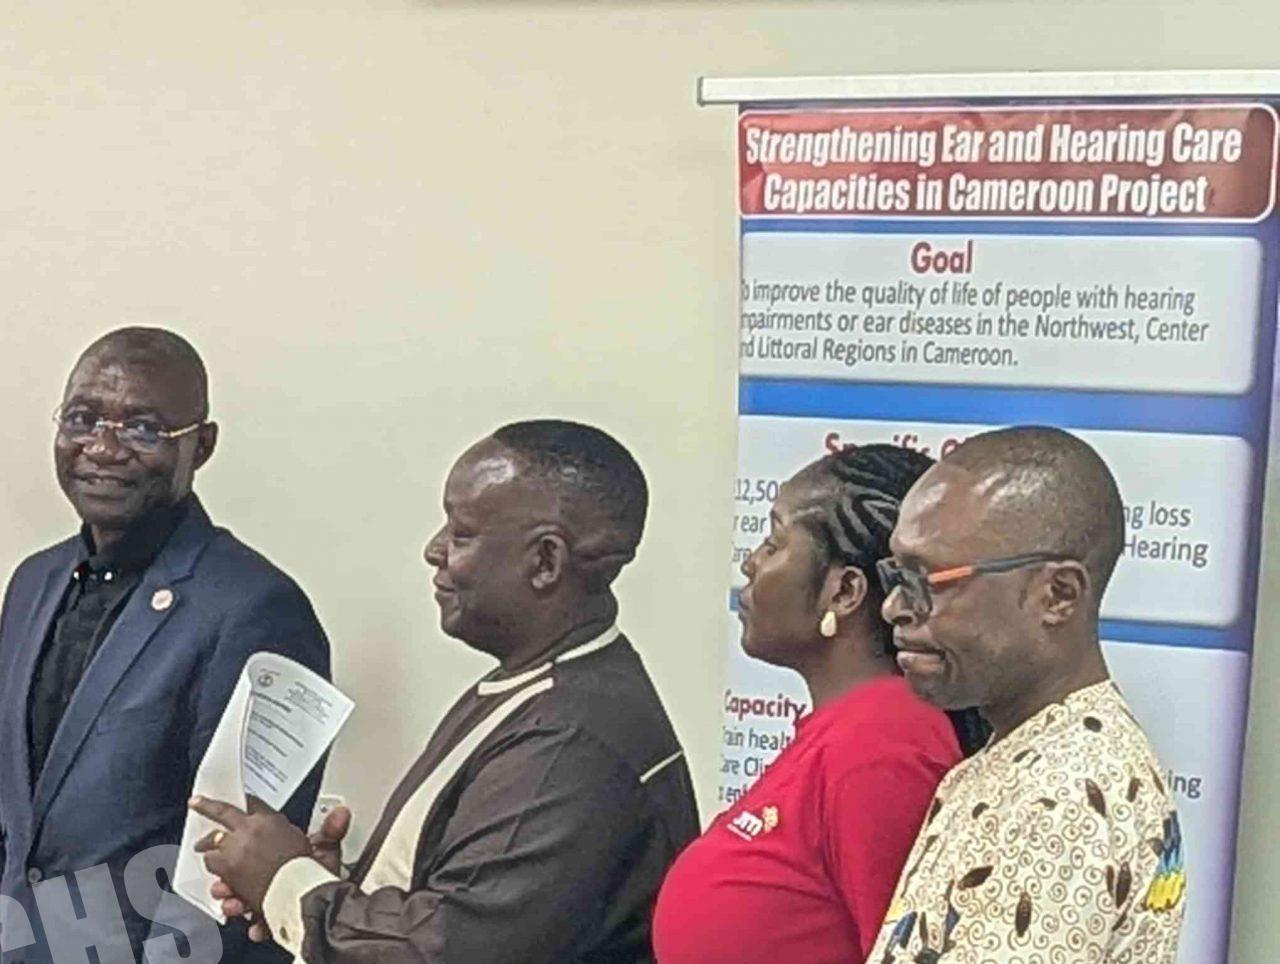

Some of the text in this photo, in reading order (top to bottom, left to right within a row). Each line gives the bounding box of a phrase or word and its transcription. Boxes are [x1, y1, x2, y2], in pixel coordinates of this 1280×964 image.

[746, 122, 1243, 168] Strengthening Ear and Hearing Care
[764, 172, 1209, 216] Capacities in Cameroon Project
[911, 240, 973, 275] Goal
[753, 278, 820, 306] improve
[825, 279, 856, 303] the
[862, 280, 926, 309] quality
[929, 281, 948, 305] of
[952, 282, 977, 306] life
[981, 282, 1003, 306] of
[1006, 284, 1070, 313] people
[1076, 284, 1118, 309] with
[1124, 284, 1195, 316] hearing
[837, 313, 858, 332] or
[863, 314, 895, 334] ear
[899, 309, 971, 336] diseases
[976, 312, 993, 335] in
[998, 313, 1030, 338] the
[1034, 315, 1140, 344] Northwest,
[1145, 317, 1209, 342] Center
[823, 338, 896, 367] Regions
[901, 340, 918, 363] in
[923, 341, 1019, 367] Cameroon.
[734, 479, 779, 503] 12,50
[1149, 500, 1192, 527] loss
